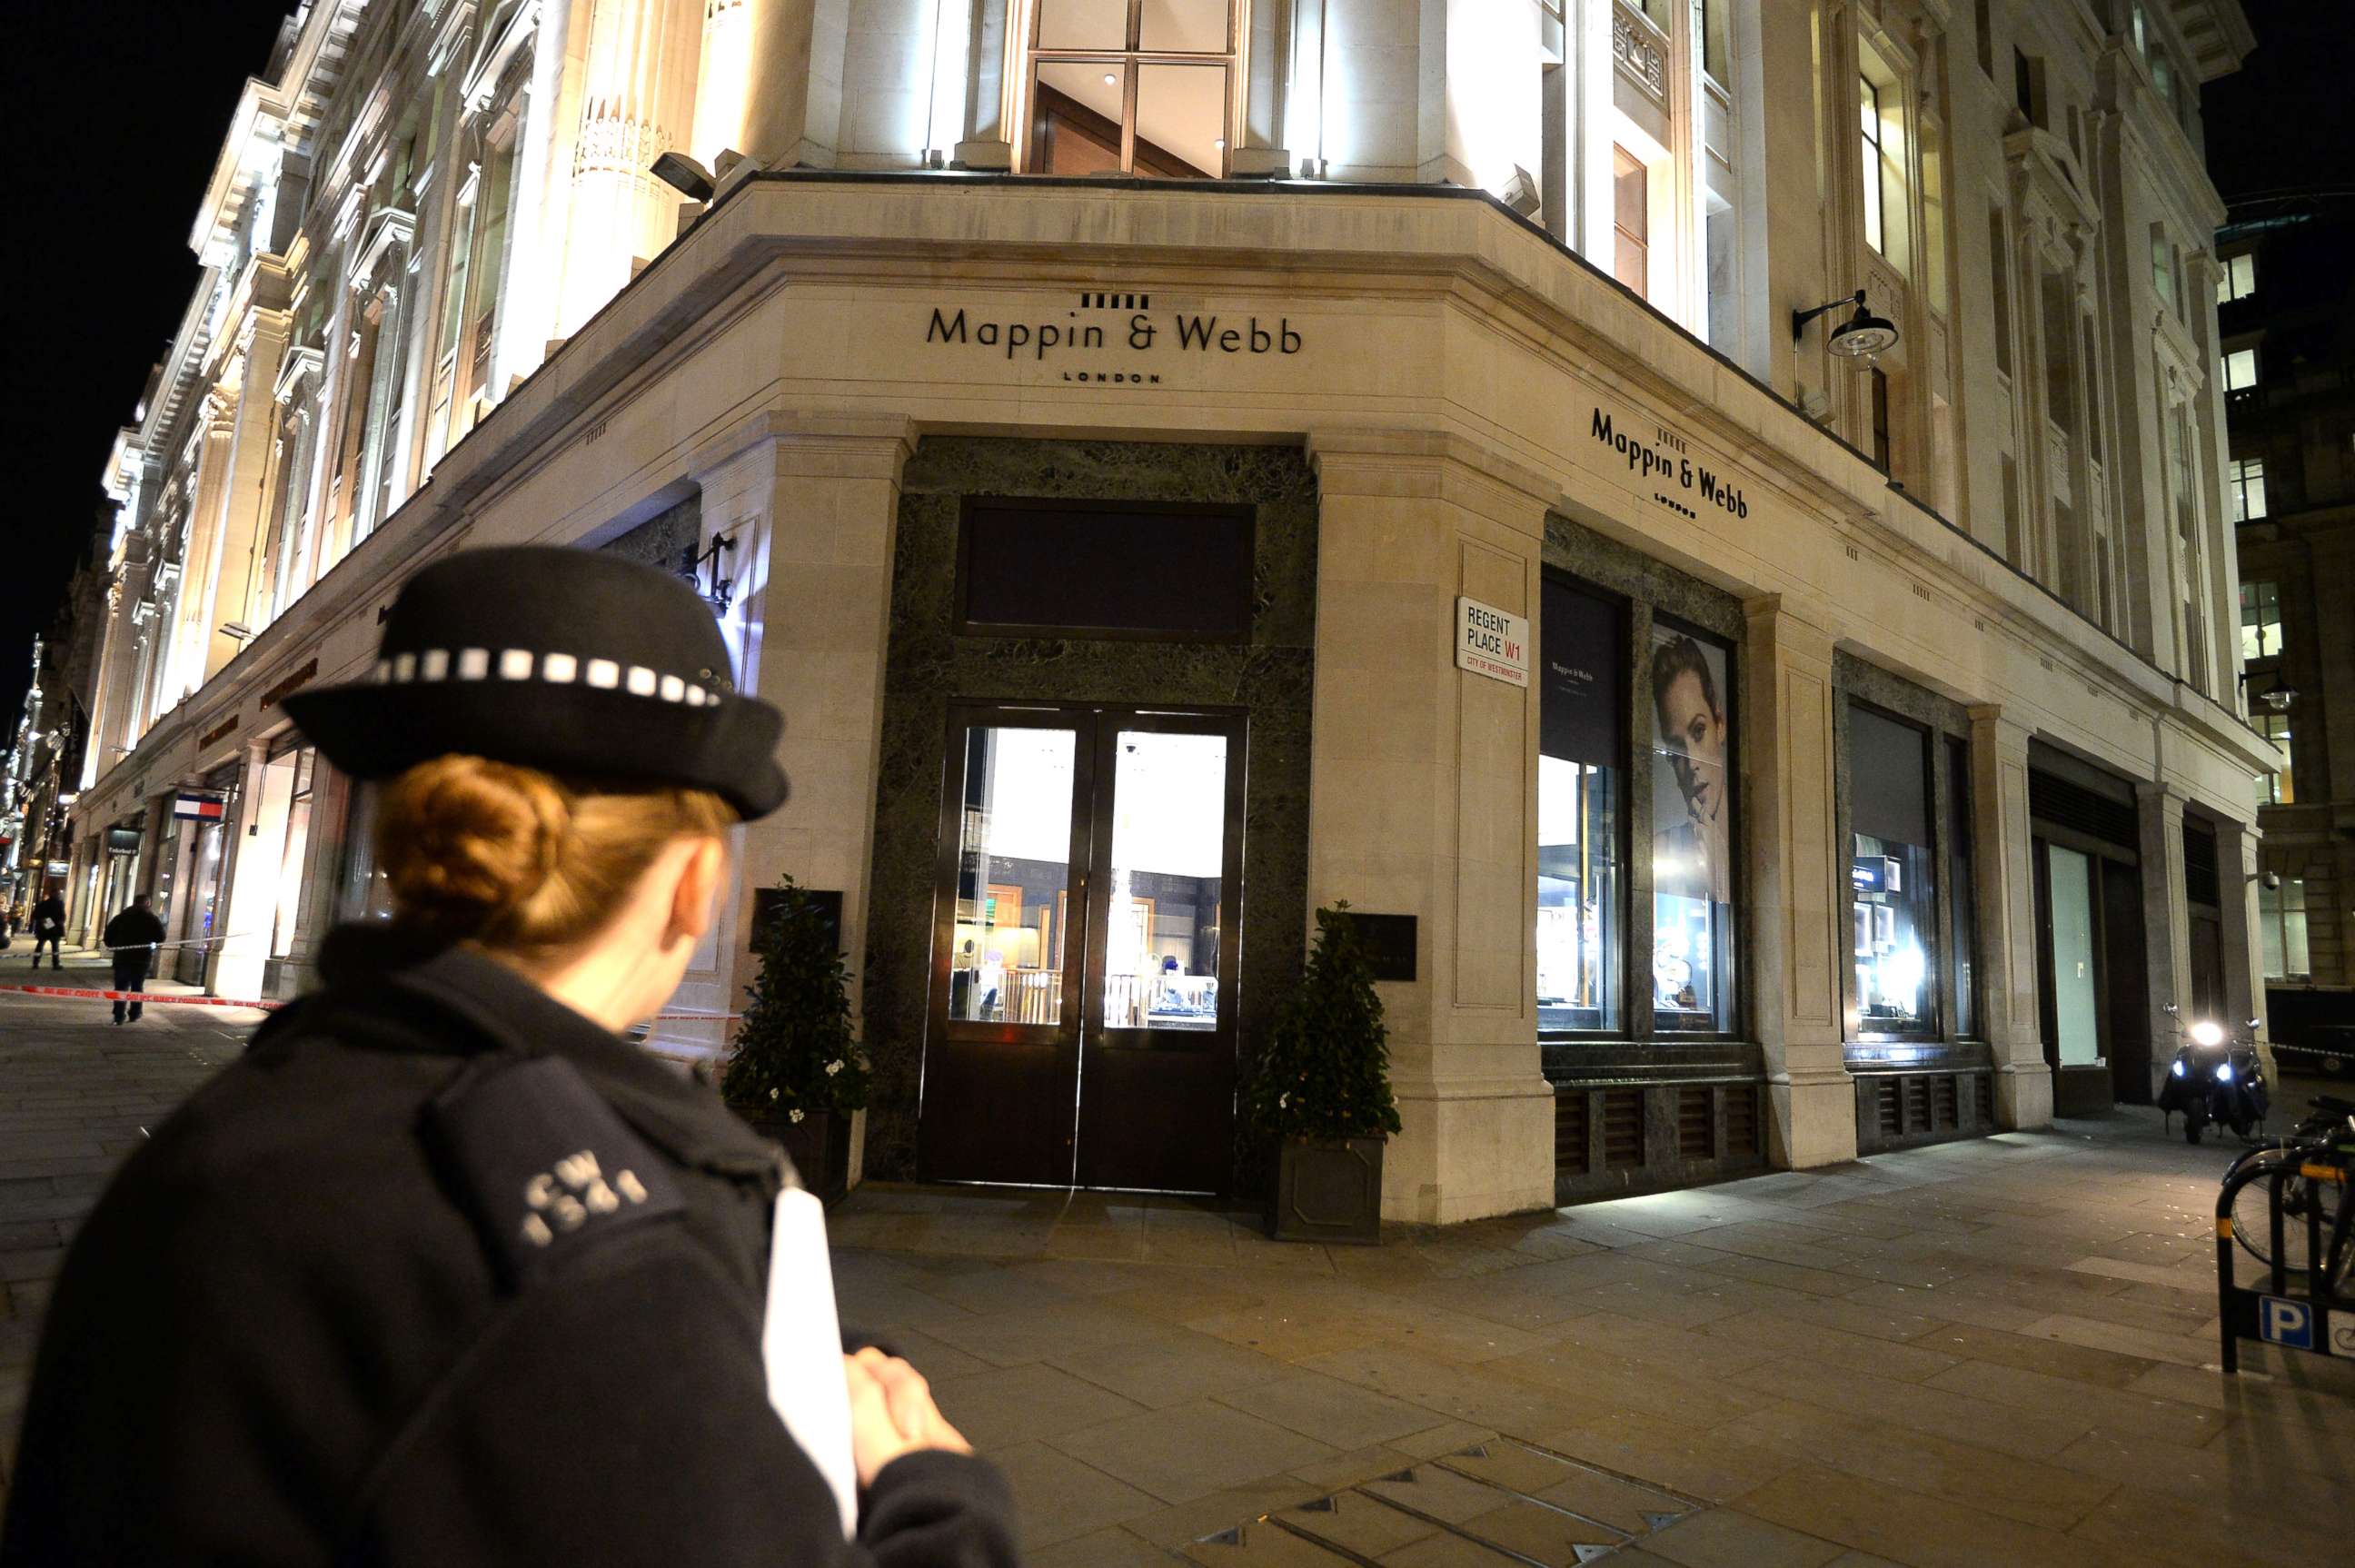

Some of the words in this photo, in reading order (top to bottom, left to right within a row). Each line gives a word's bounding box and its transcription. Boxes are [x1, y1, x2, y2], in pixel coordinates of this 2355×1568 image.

[927, 308, 1104, 360] Mappin
[1128, 314, 1158, 351] &
[1176, 313, 1302, 354] Webb
[1063, 371, 1160, 383] LONDON
[1592, 407, 1673, 478] Mappin
[1680, 459, 1694, 489] &
[1698, 467, 1748, 519] Webb
[1467, 606, 1510, 636] REGENT
[1467, 629, 1501, 655] PLACE
[1505, 640, 1520, 661] W1
[1467, 656, 1478, 667] CITY
[1479, 660, 1486, 670] OF
[1487, 663, 1522, 680] WESTMINSTER
[2271, 1301, 2304, 1340] P
